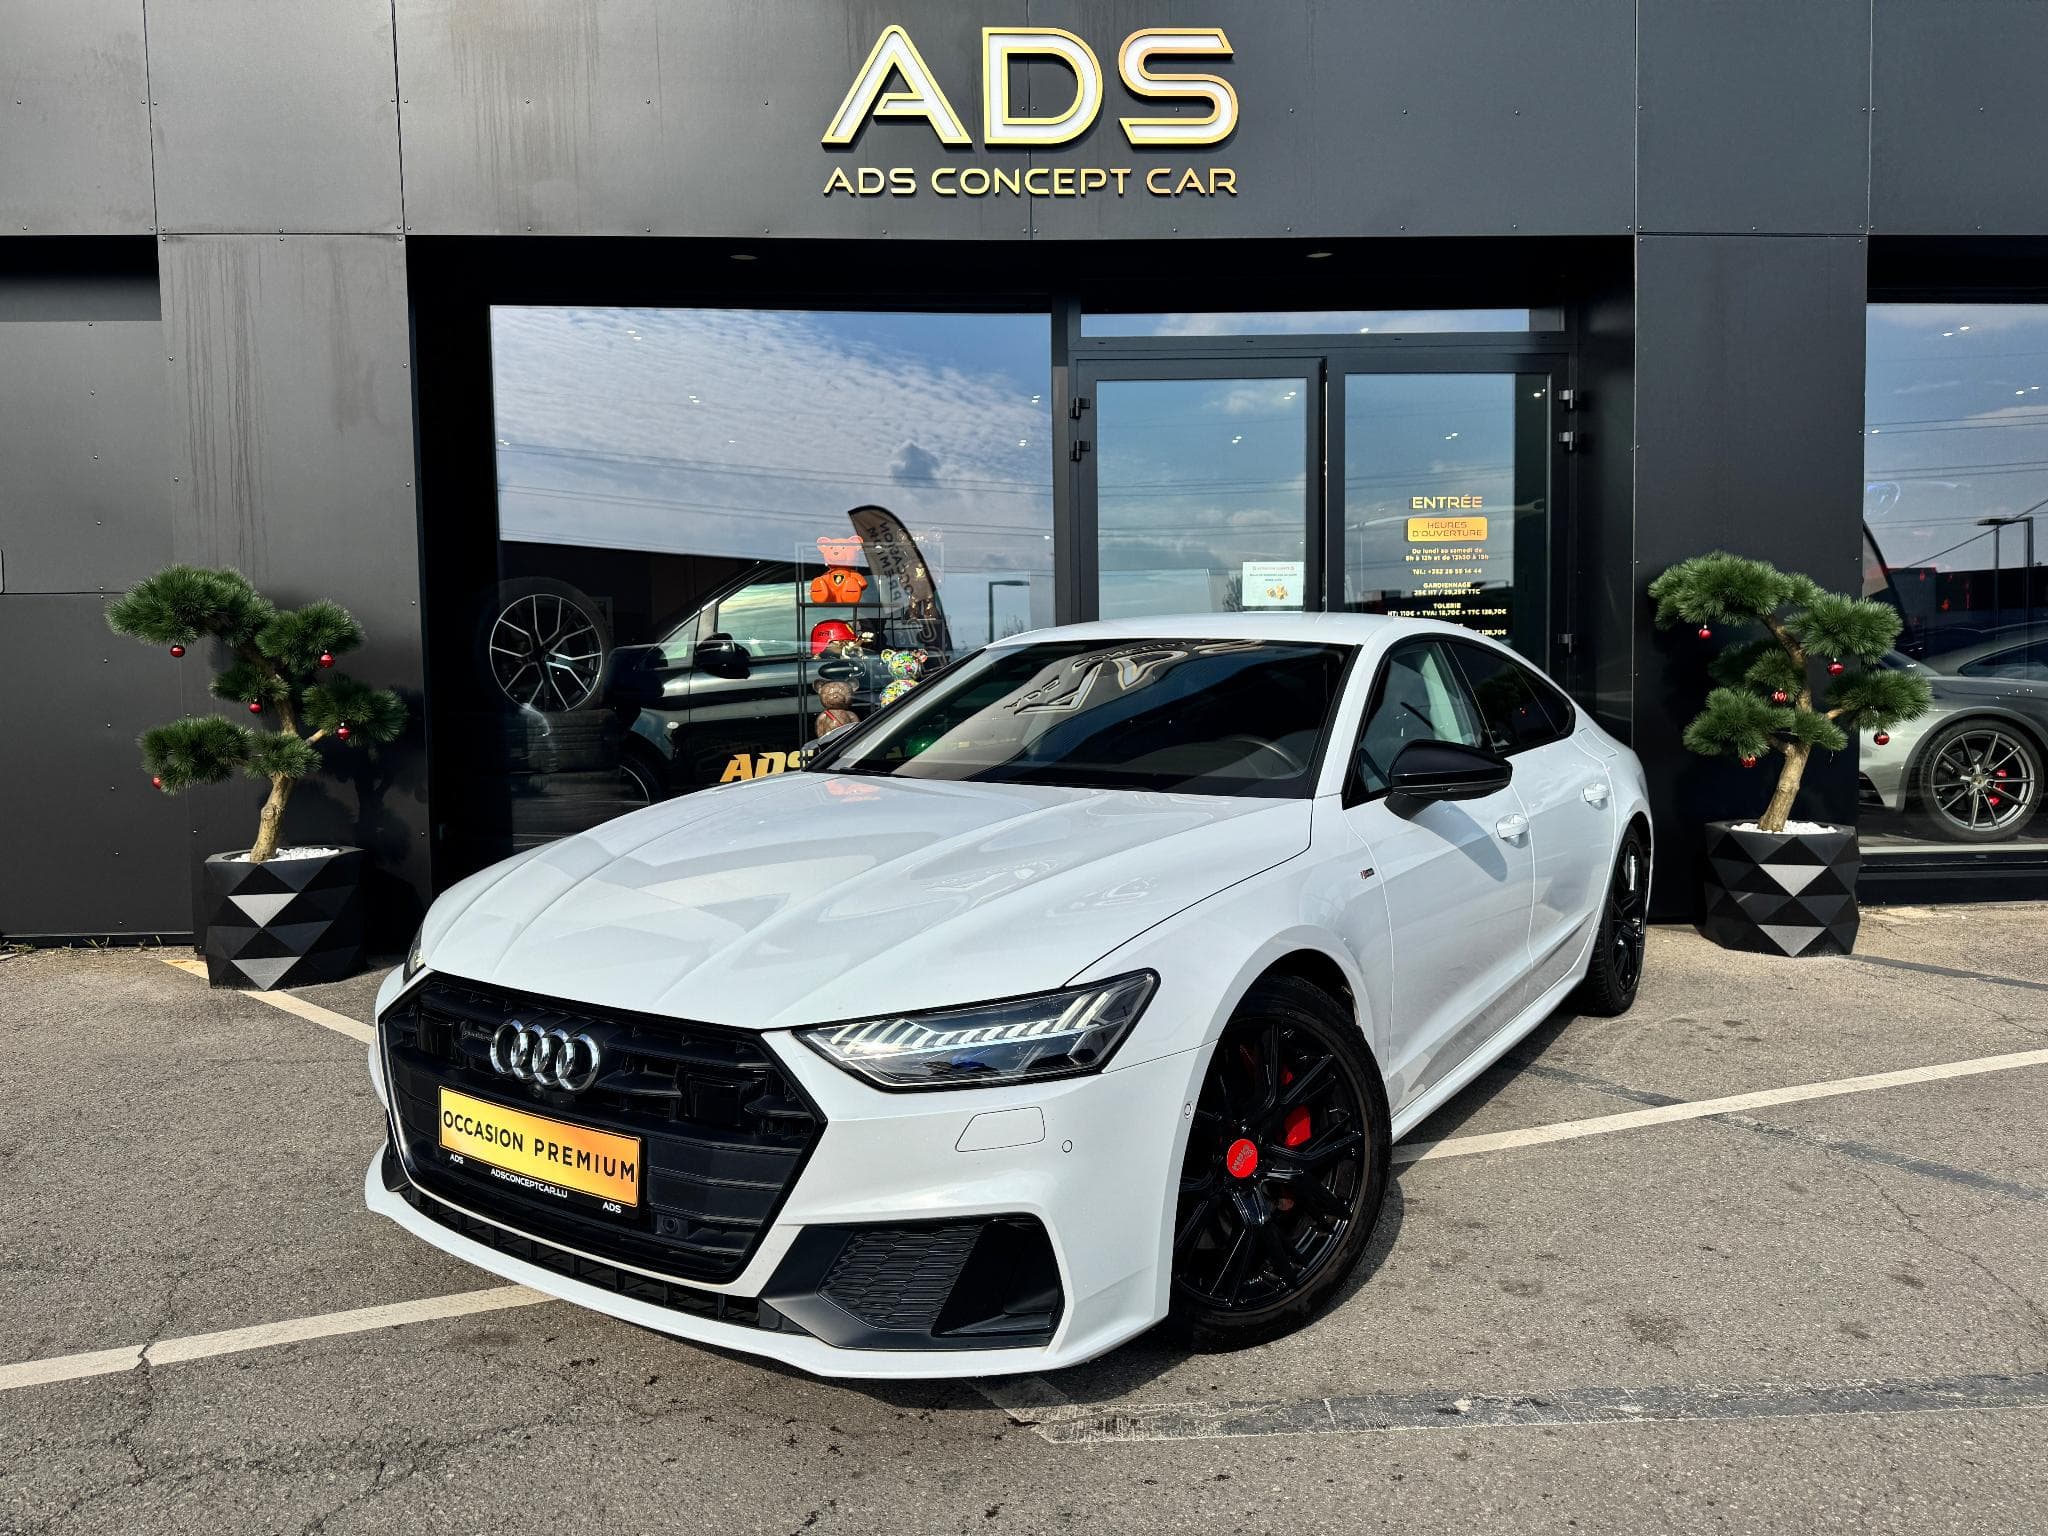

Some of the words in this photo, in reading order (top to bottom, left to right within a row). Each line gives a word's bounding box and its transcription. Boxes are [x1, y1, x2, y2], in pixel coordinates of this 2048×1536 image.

[820, 25, 1239, 145] ADS
[823, 167, 917, 196] ADS
[931, 168, 1131, 196] CONCEPT
[1146, 168, 1238, 196] CAR
[1412, 494, 1482, 509] ENTRÉE
[1427, 521, 1468, 529] HEURES
[1412, 529, 1482, 538] D'OUVERTURE
[443, 1110, 524, 1152] OCCASION
[534, 1138, 635, 1183] PREMIUM
[450, 1153, 464, 1165] ADS
[490, 1168, 568, 1199] ADSCONCEPTCAR.LU
[602, 1201, 622, 1214] ADS
